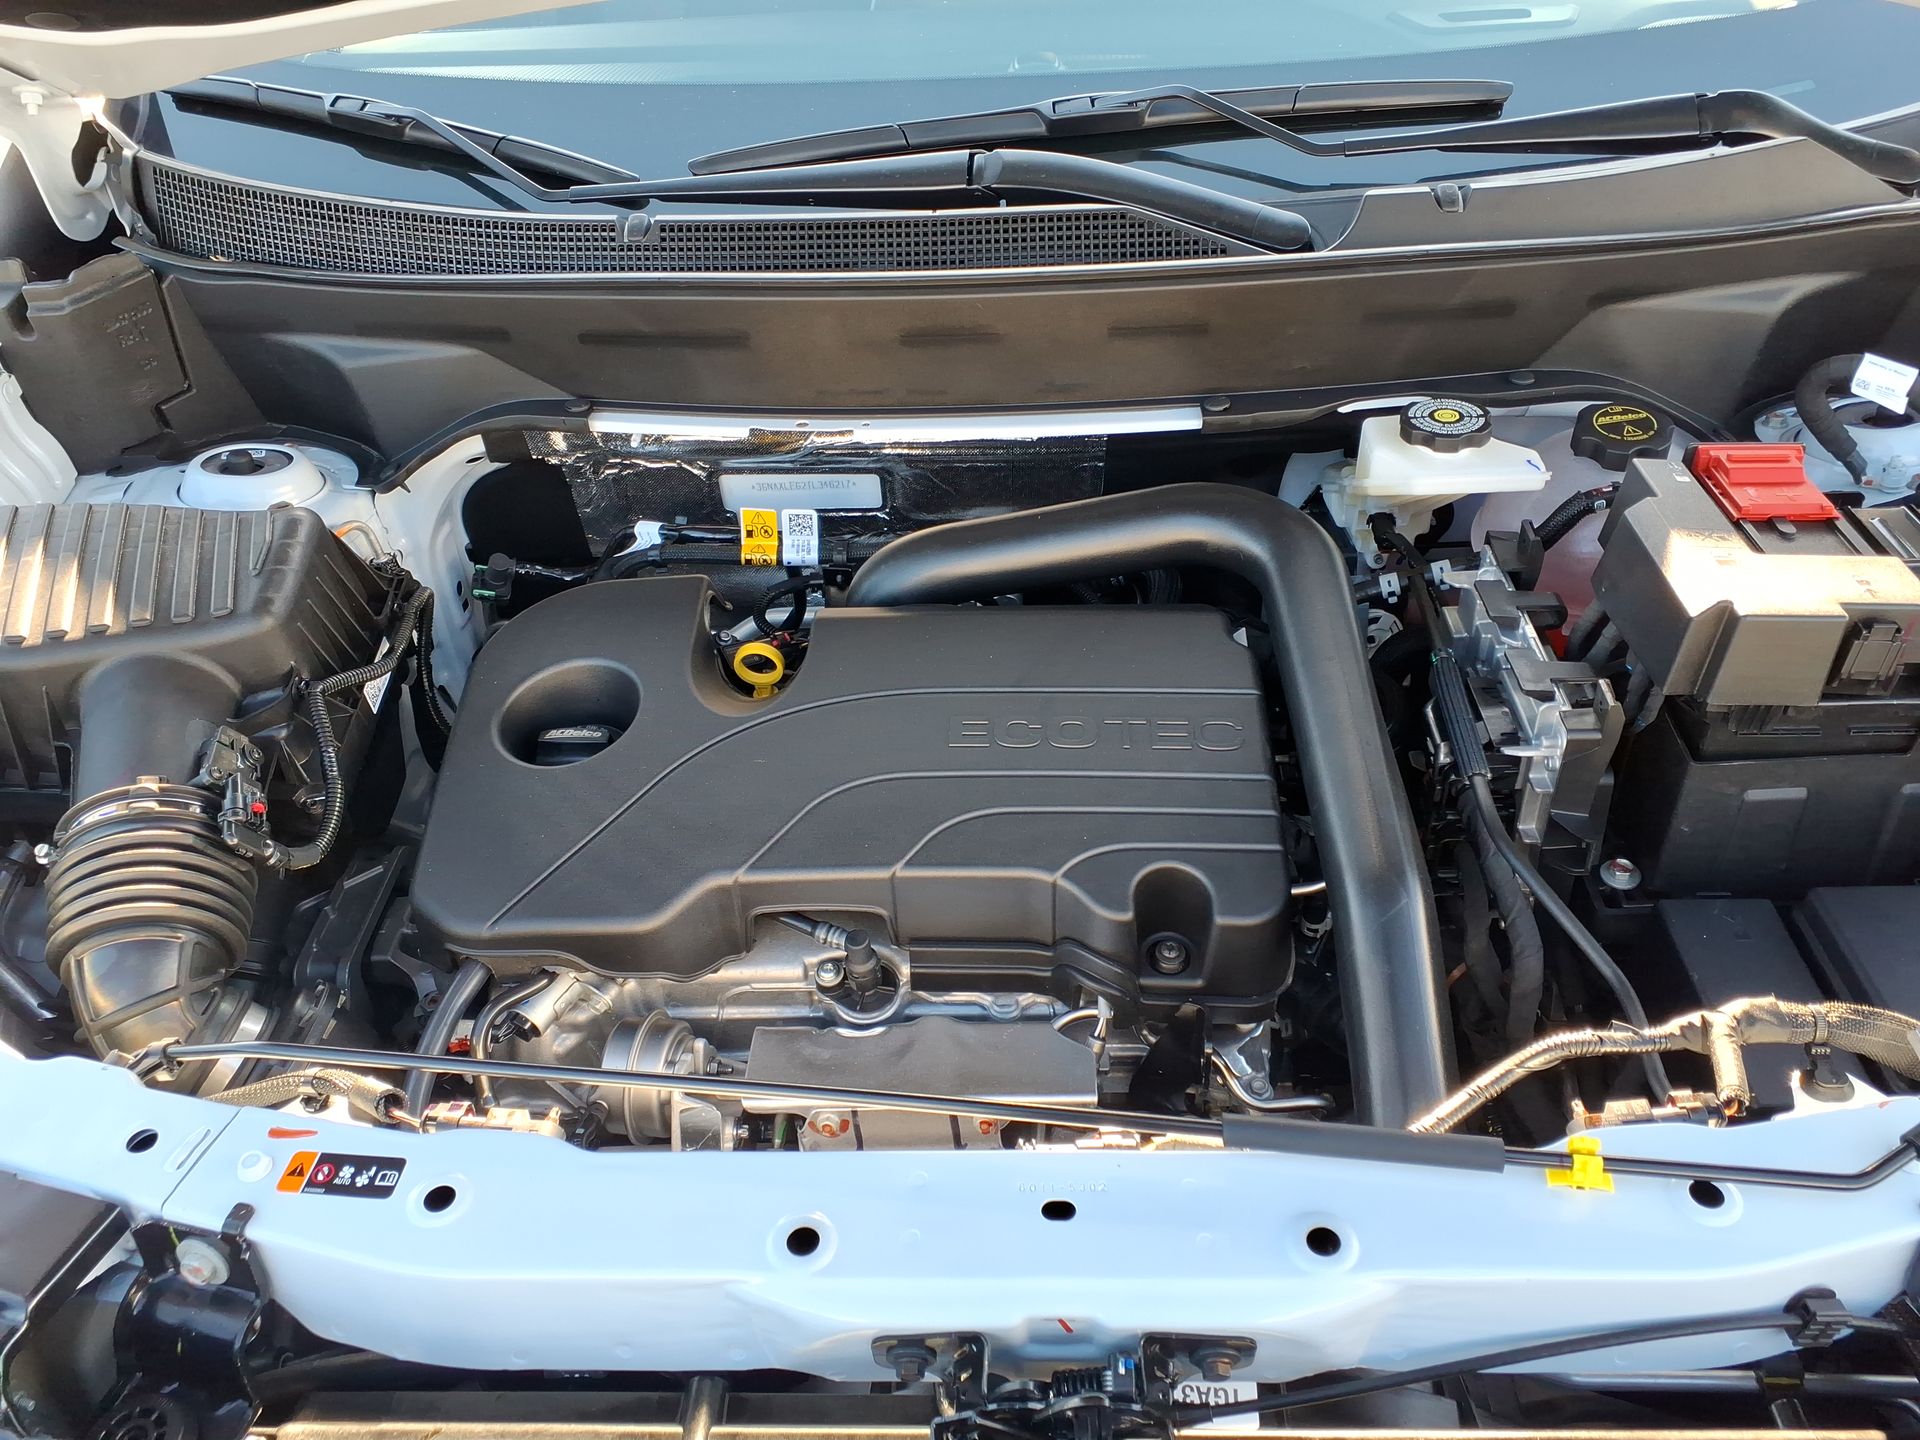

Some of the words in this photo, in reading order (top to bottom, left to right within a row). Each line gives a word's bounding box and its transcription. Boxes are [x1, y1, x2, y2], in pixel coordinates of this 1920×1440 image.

[1597, 413, 1647, 425] ACDelco
[544, 728, 602, 739] ACDelco
[948, 715, 1246, 752] ECOTEC
[333, 1177, 352, 1186] AUTO
